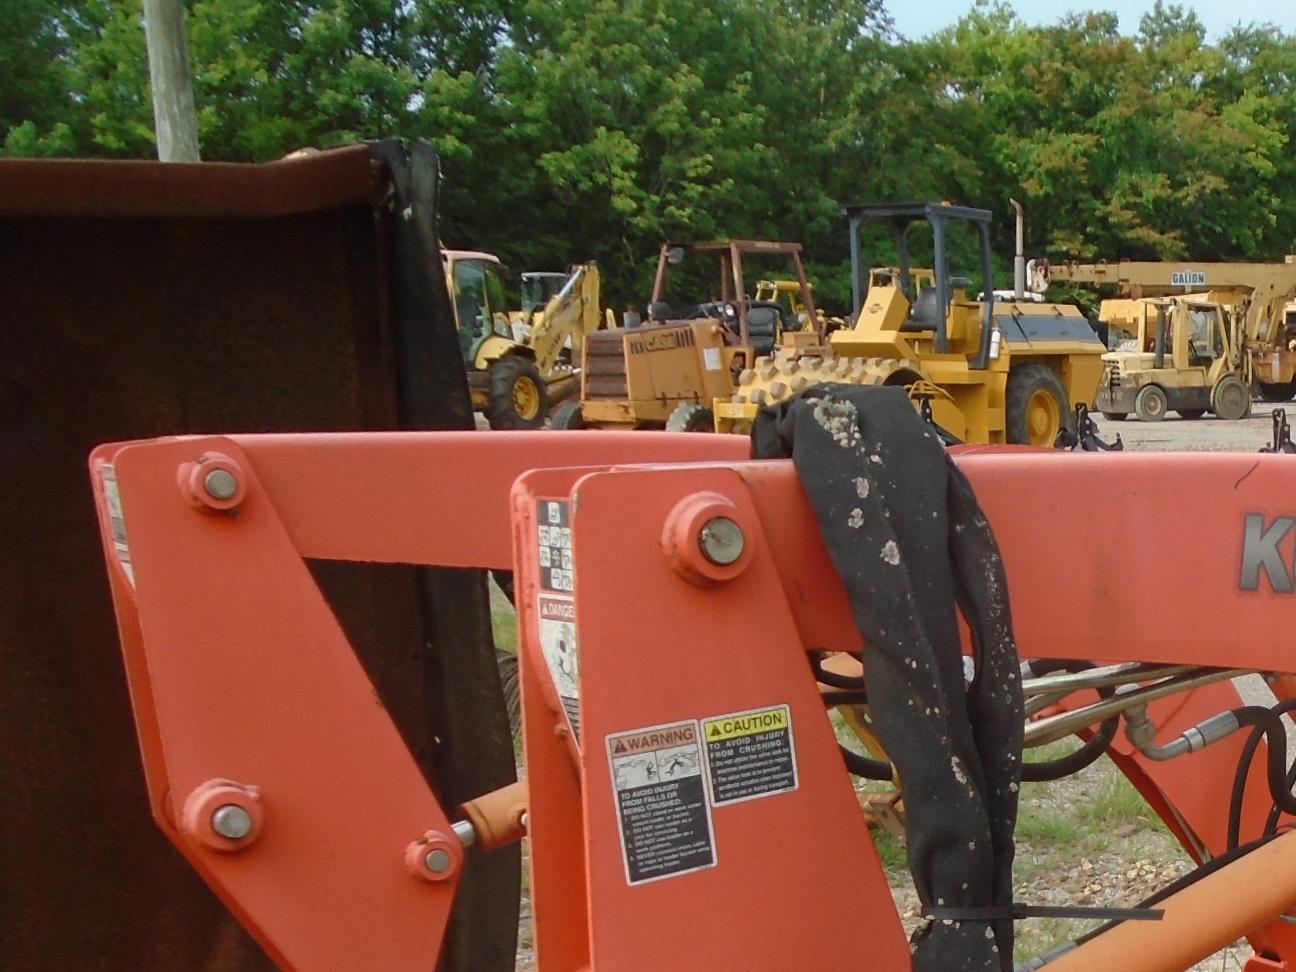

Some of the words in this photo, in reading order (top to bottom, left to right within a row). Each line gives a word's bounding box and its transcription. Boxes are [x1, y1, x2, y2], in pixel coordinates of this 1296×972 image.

[1173, 273, 1204, 283] GALION
[549, 602, 574, 618] DANGE
[723, 712, 782, 734] CAUTION
[627, 728, 693, 750] WARNING
[708, 742, 720, 750] TO
[725, 738, 750, 746] AVOID
[755, 731, 784, 740] INJURY
[709, 749, 733, 758] FROM
[621, 792, 630, 800] TO
[631, 788, 653, 797] AVOID
[654, 783, 679, 792] INJURY
[643, 794, 665, 802] FALLS
[666, 790, 677, 798] OR
[623, 806, 645, 814] BEING
